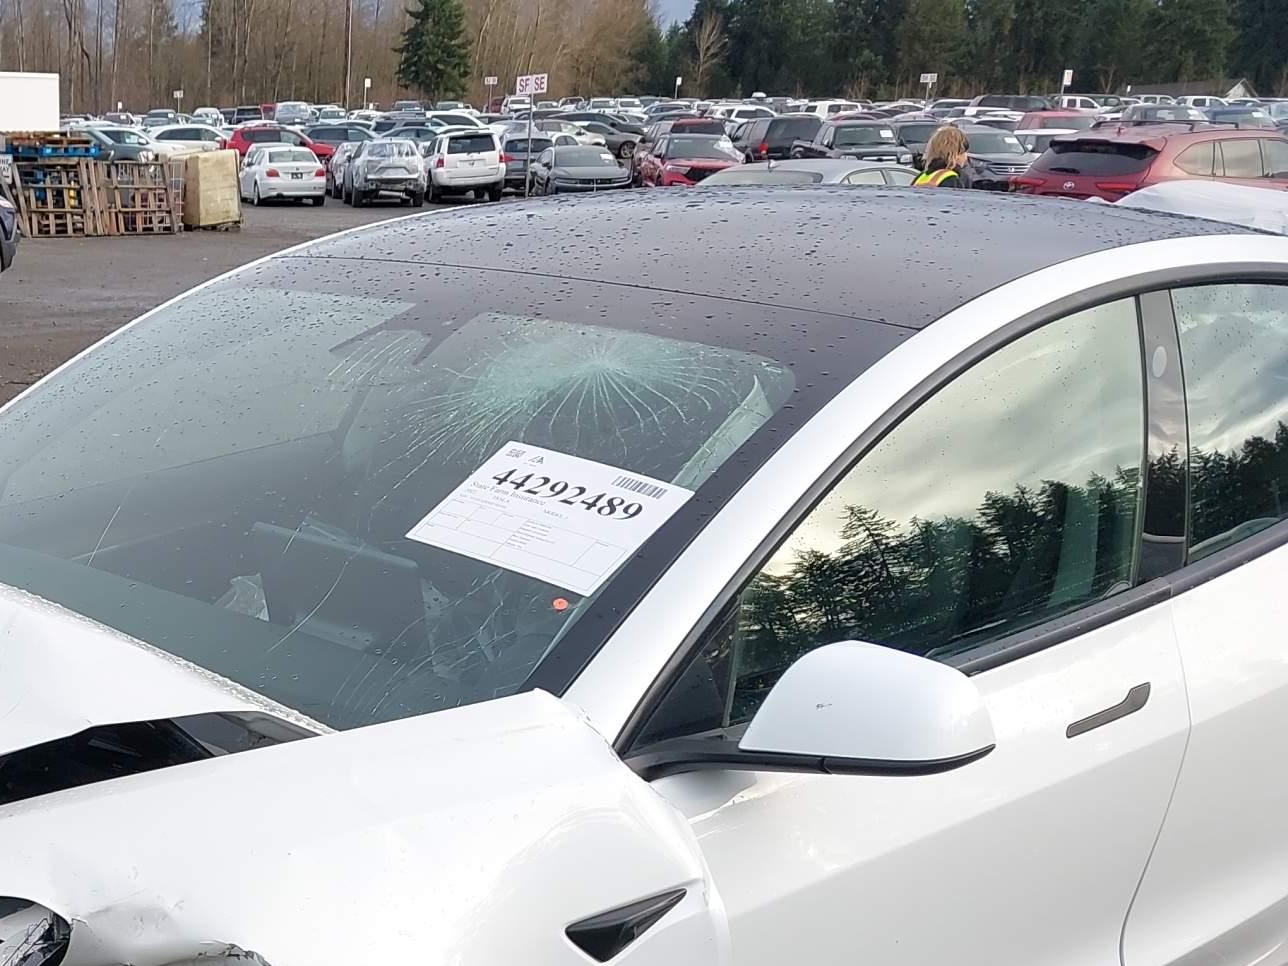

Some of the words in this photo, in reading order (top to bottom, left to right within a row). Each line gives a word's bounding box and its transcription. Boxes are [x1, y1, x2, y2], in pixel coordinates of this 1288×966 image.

[519, 78, 530, 92] SF
[534, 76, 545, 91] SE
[492, 468, 643, 520] 44292489
